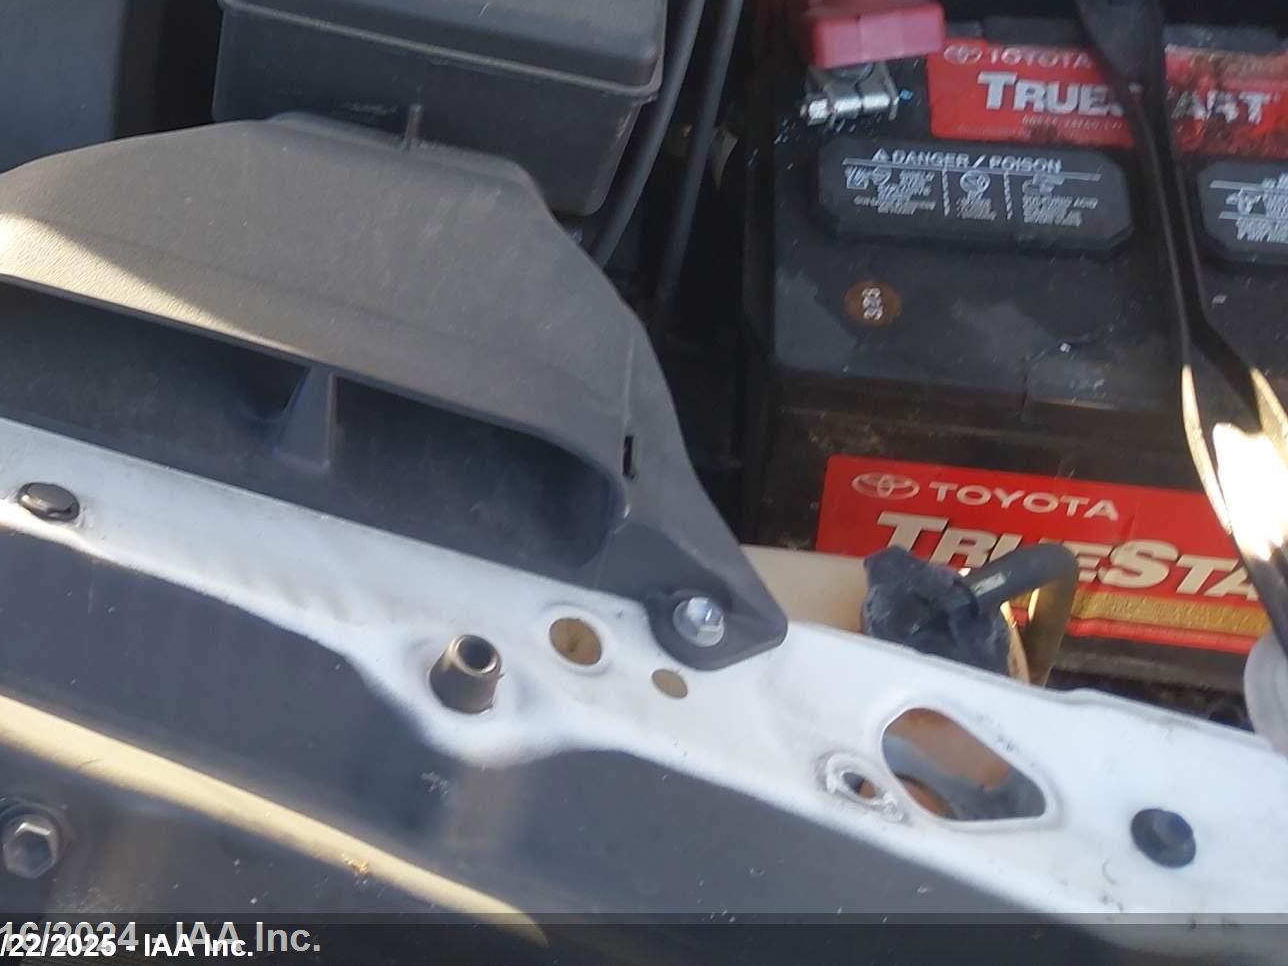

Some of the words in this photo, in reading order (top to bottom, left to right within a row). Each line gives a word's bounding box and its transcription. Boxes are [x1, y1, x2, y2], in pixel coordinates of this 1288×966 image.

[988, 46, 1095, 69] TOYOTA
[891, 149, 970, 170] DANGER
[988, 154, 1062, 174] POISON
[928, 481, 1120, 522] TOYOTA
